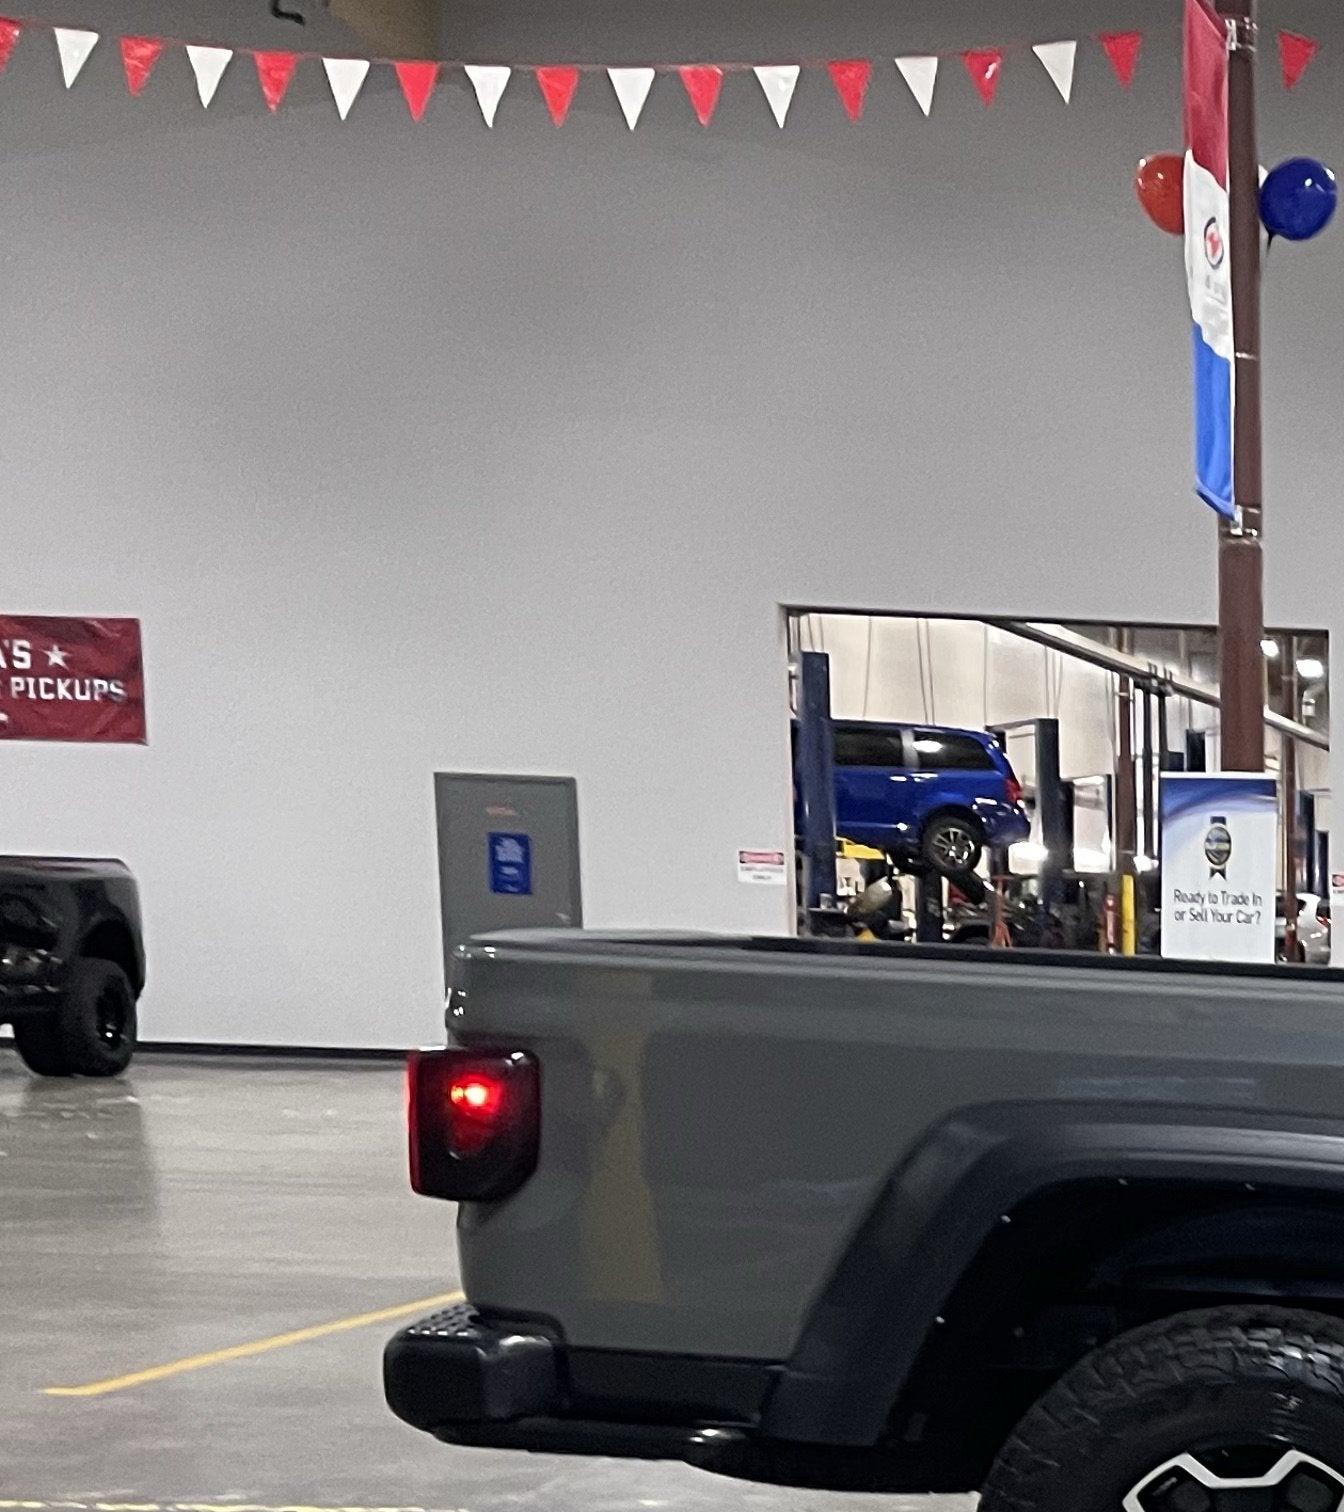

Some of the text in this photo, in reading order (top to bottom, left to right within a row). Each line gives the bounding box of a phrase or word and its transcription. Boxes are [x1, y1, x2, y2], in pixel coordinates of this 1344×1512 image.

[0, 639, 31, 669] 'S
[10, 677, 127, 703] PICKUPS
[1173, 889, 1263, 906] Ready to Trade In
[1174, 907, 1262, 924] or Sell Your Car?
